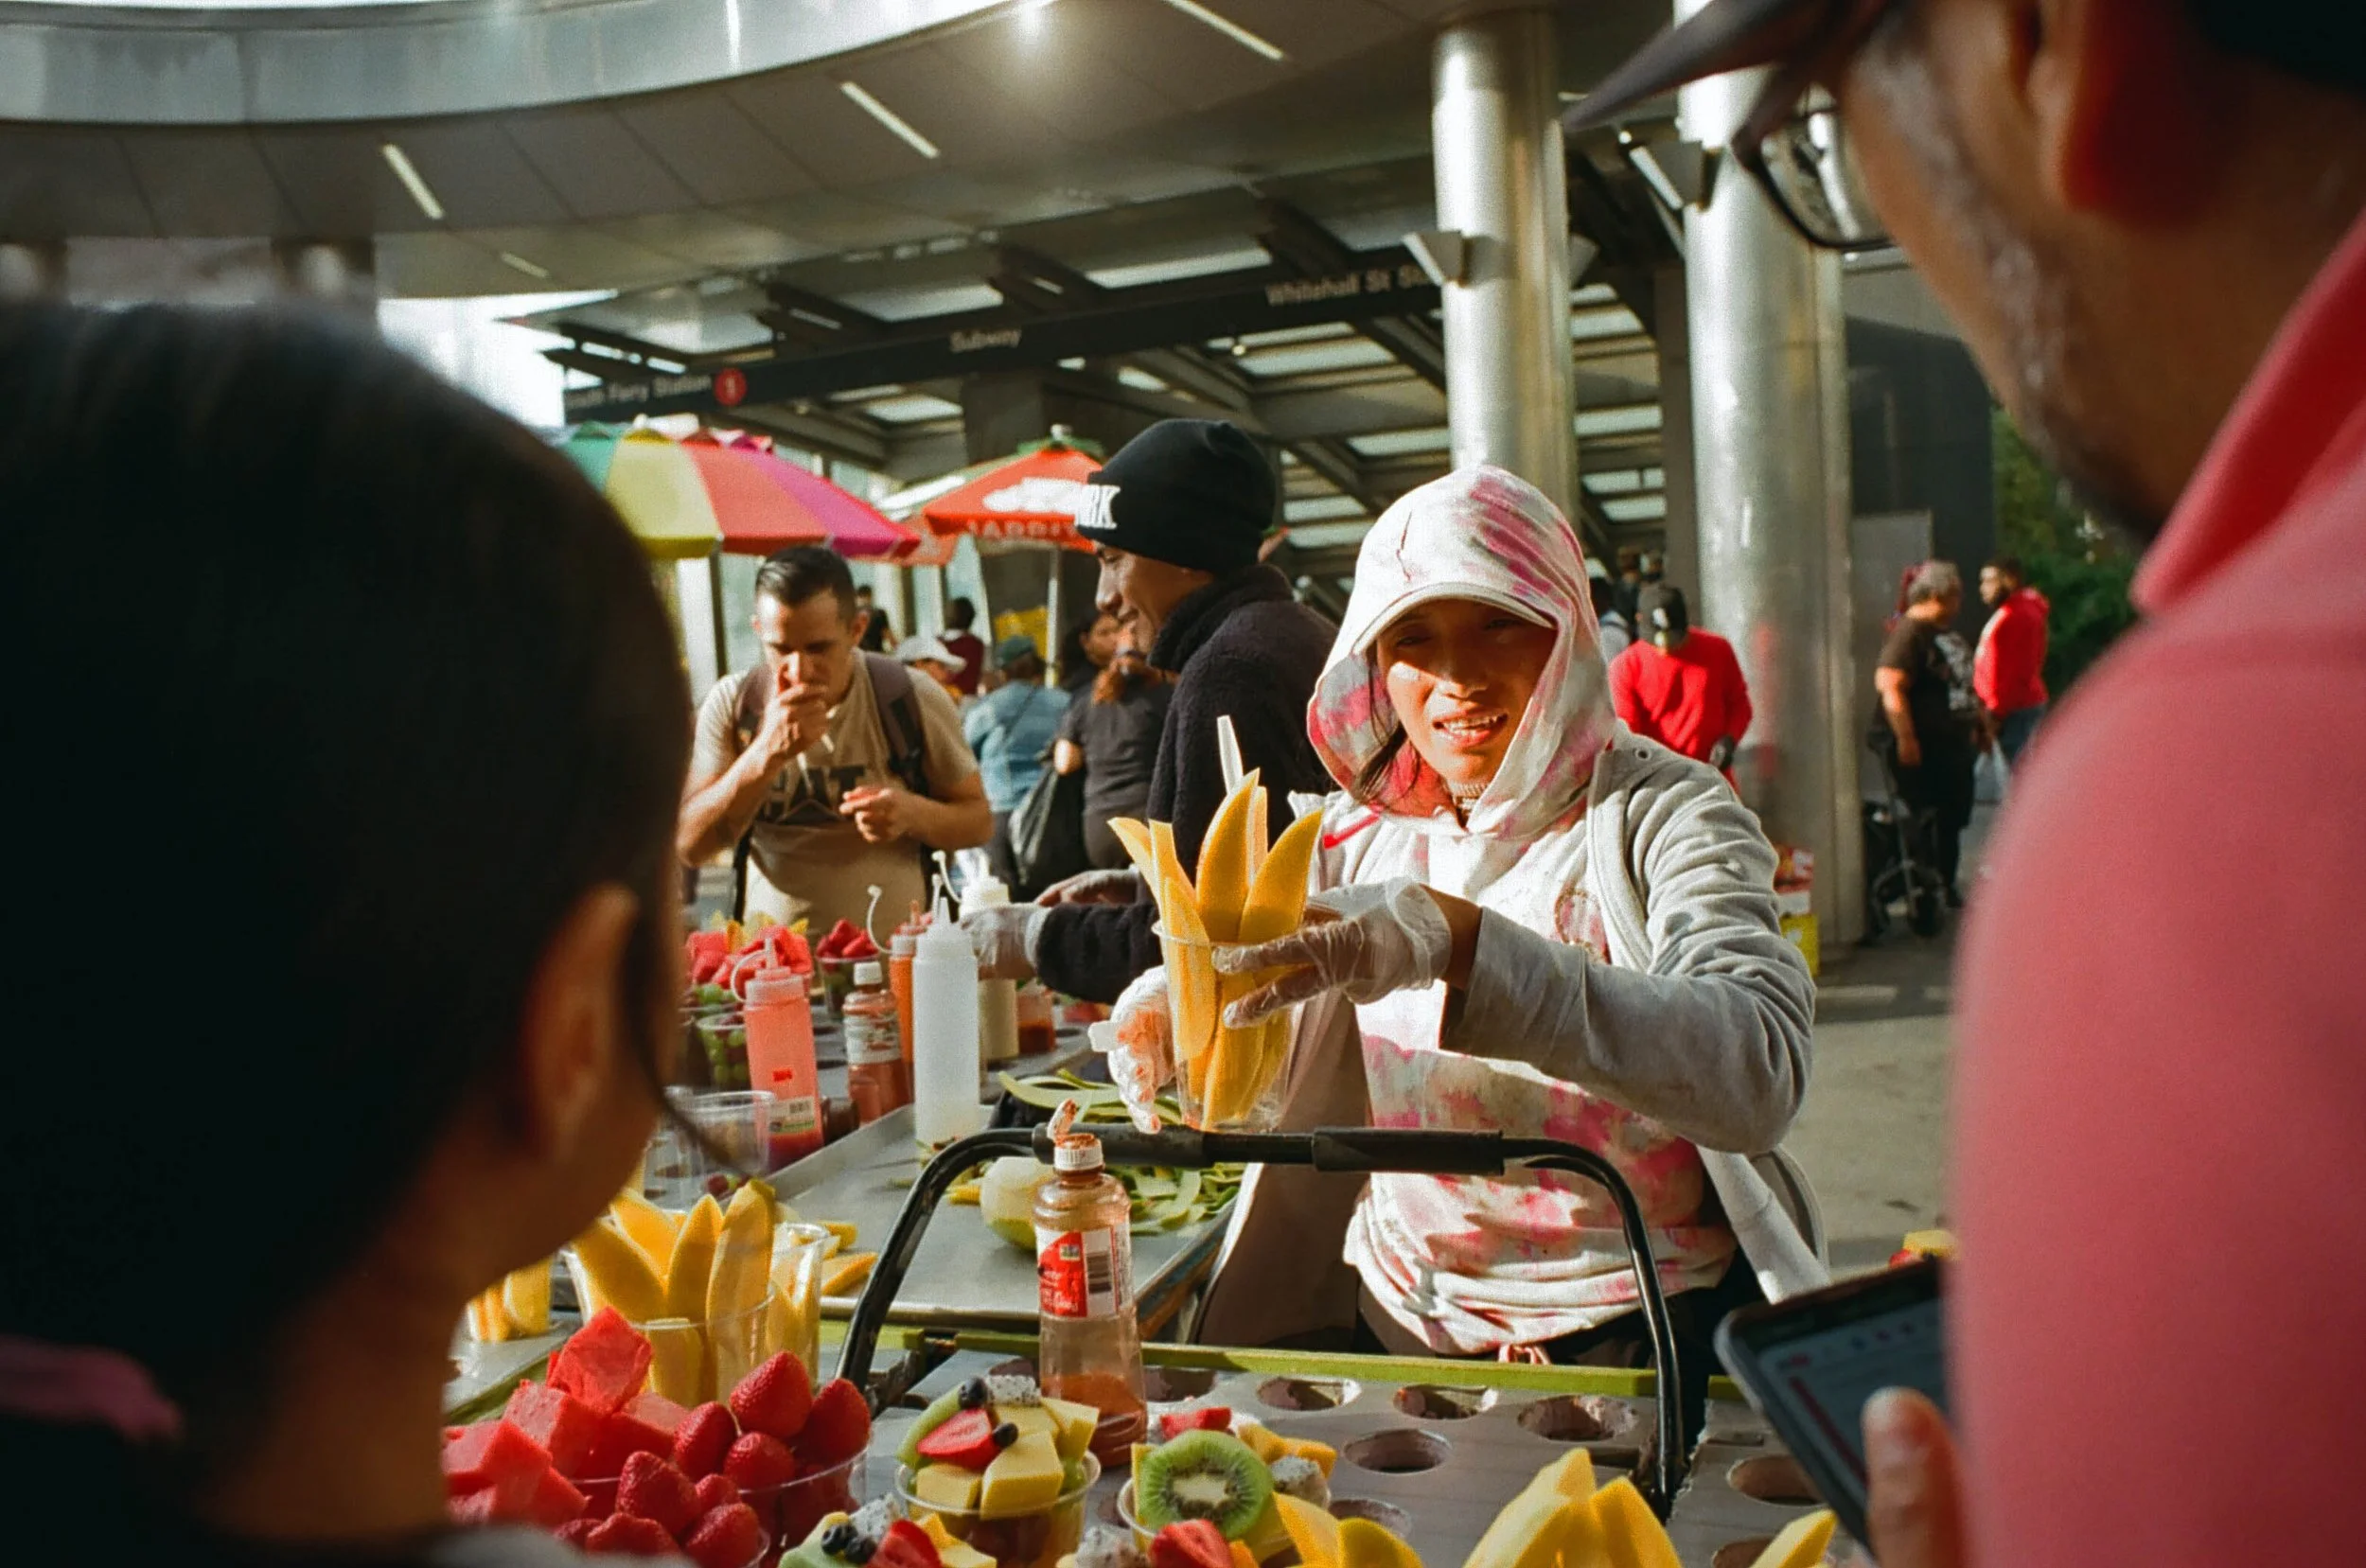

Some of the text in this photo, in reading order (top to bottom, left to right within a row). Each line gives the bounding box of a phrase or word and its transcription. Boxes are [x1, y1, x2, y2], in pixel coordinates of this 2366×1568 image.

[1265, 272, 1360, 307] Whitehall
[1365, 268, 1390, 293] St
[949, 330, 1021, 353] Subway
[652, 374, 713, 397] Station
